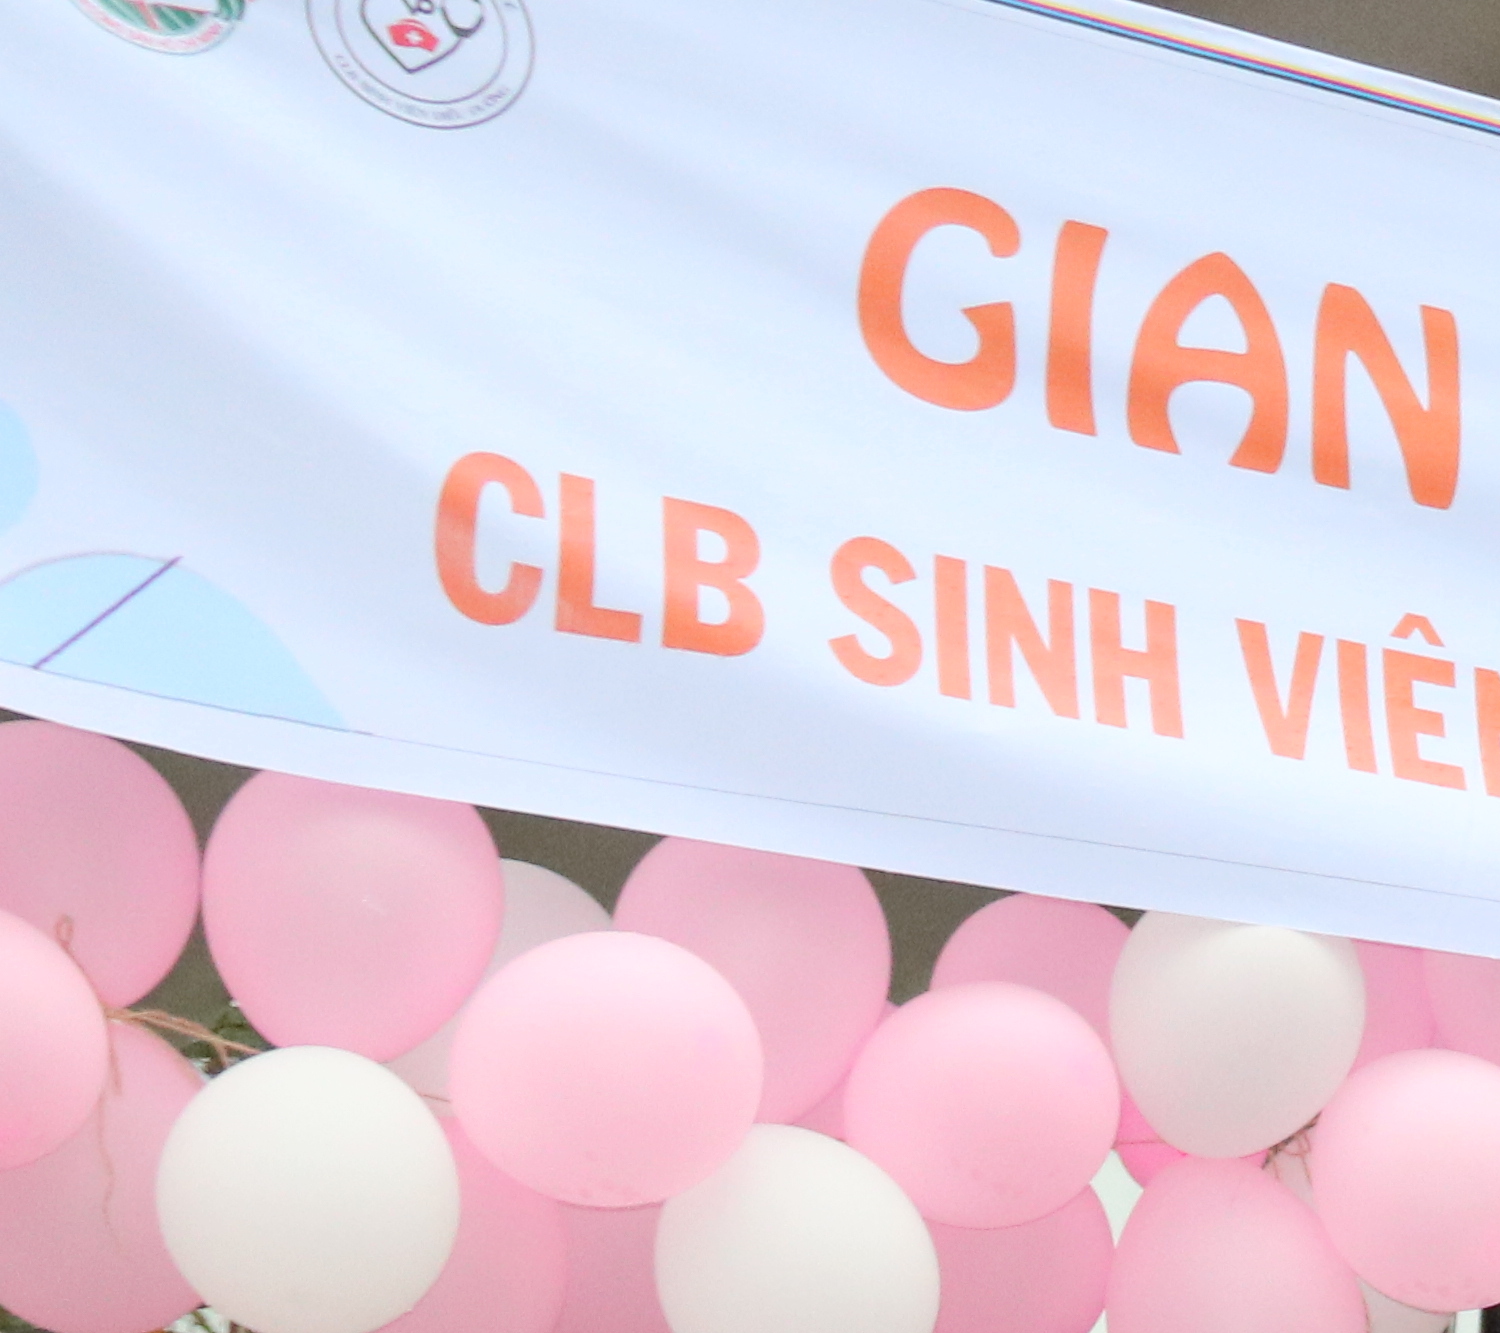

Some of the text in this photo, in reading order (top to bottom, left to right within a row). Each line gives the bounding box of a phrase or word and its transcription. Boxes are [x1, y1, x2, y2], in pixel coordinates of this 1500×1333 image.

[857, 186, 1462, 510] GIAN
[432, 451, 767, 658] CLB
[829, 535, 1184, 740] SINH
